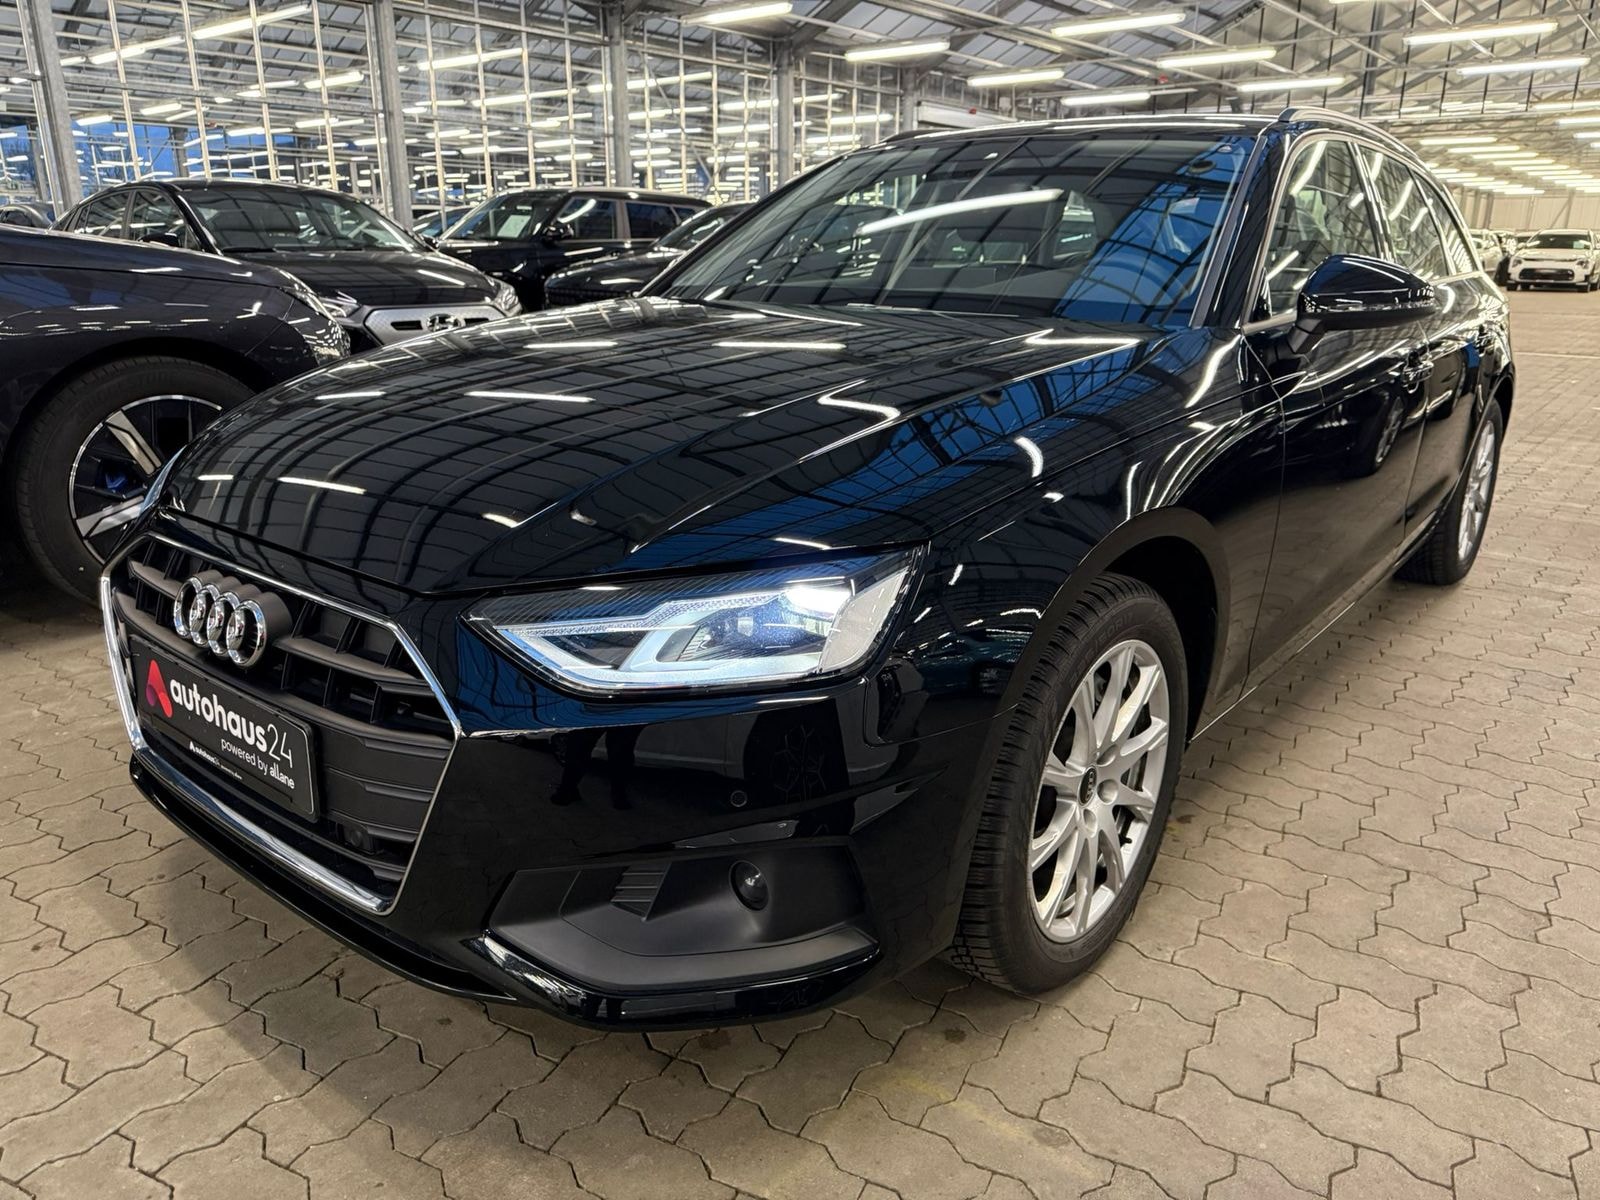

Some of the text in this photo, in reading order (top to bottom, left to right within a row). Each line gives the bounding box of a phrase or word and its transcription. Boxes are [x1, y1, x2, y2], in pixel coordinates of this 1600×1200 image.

[170, 679, 293, 768] autohaus24
[221, 739, 256, 766] powered
[257, 756, 268, 776] by
[270, 763, 295, 789] allane
